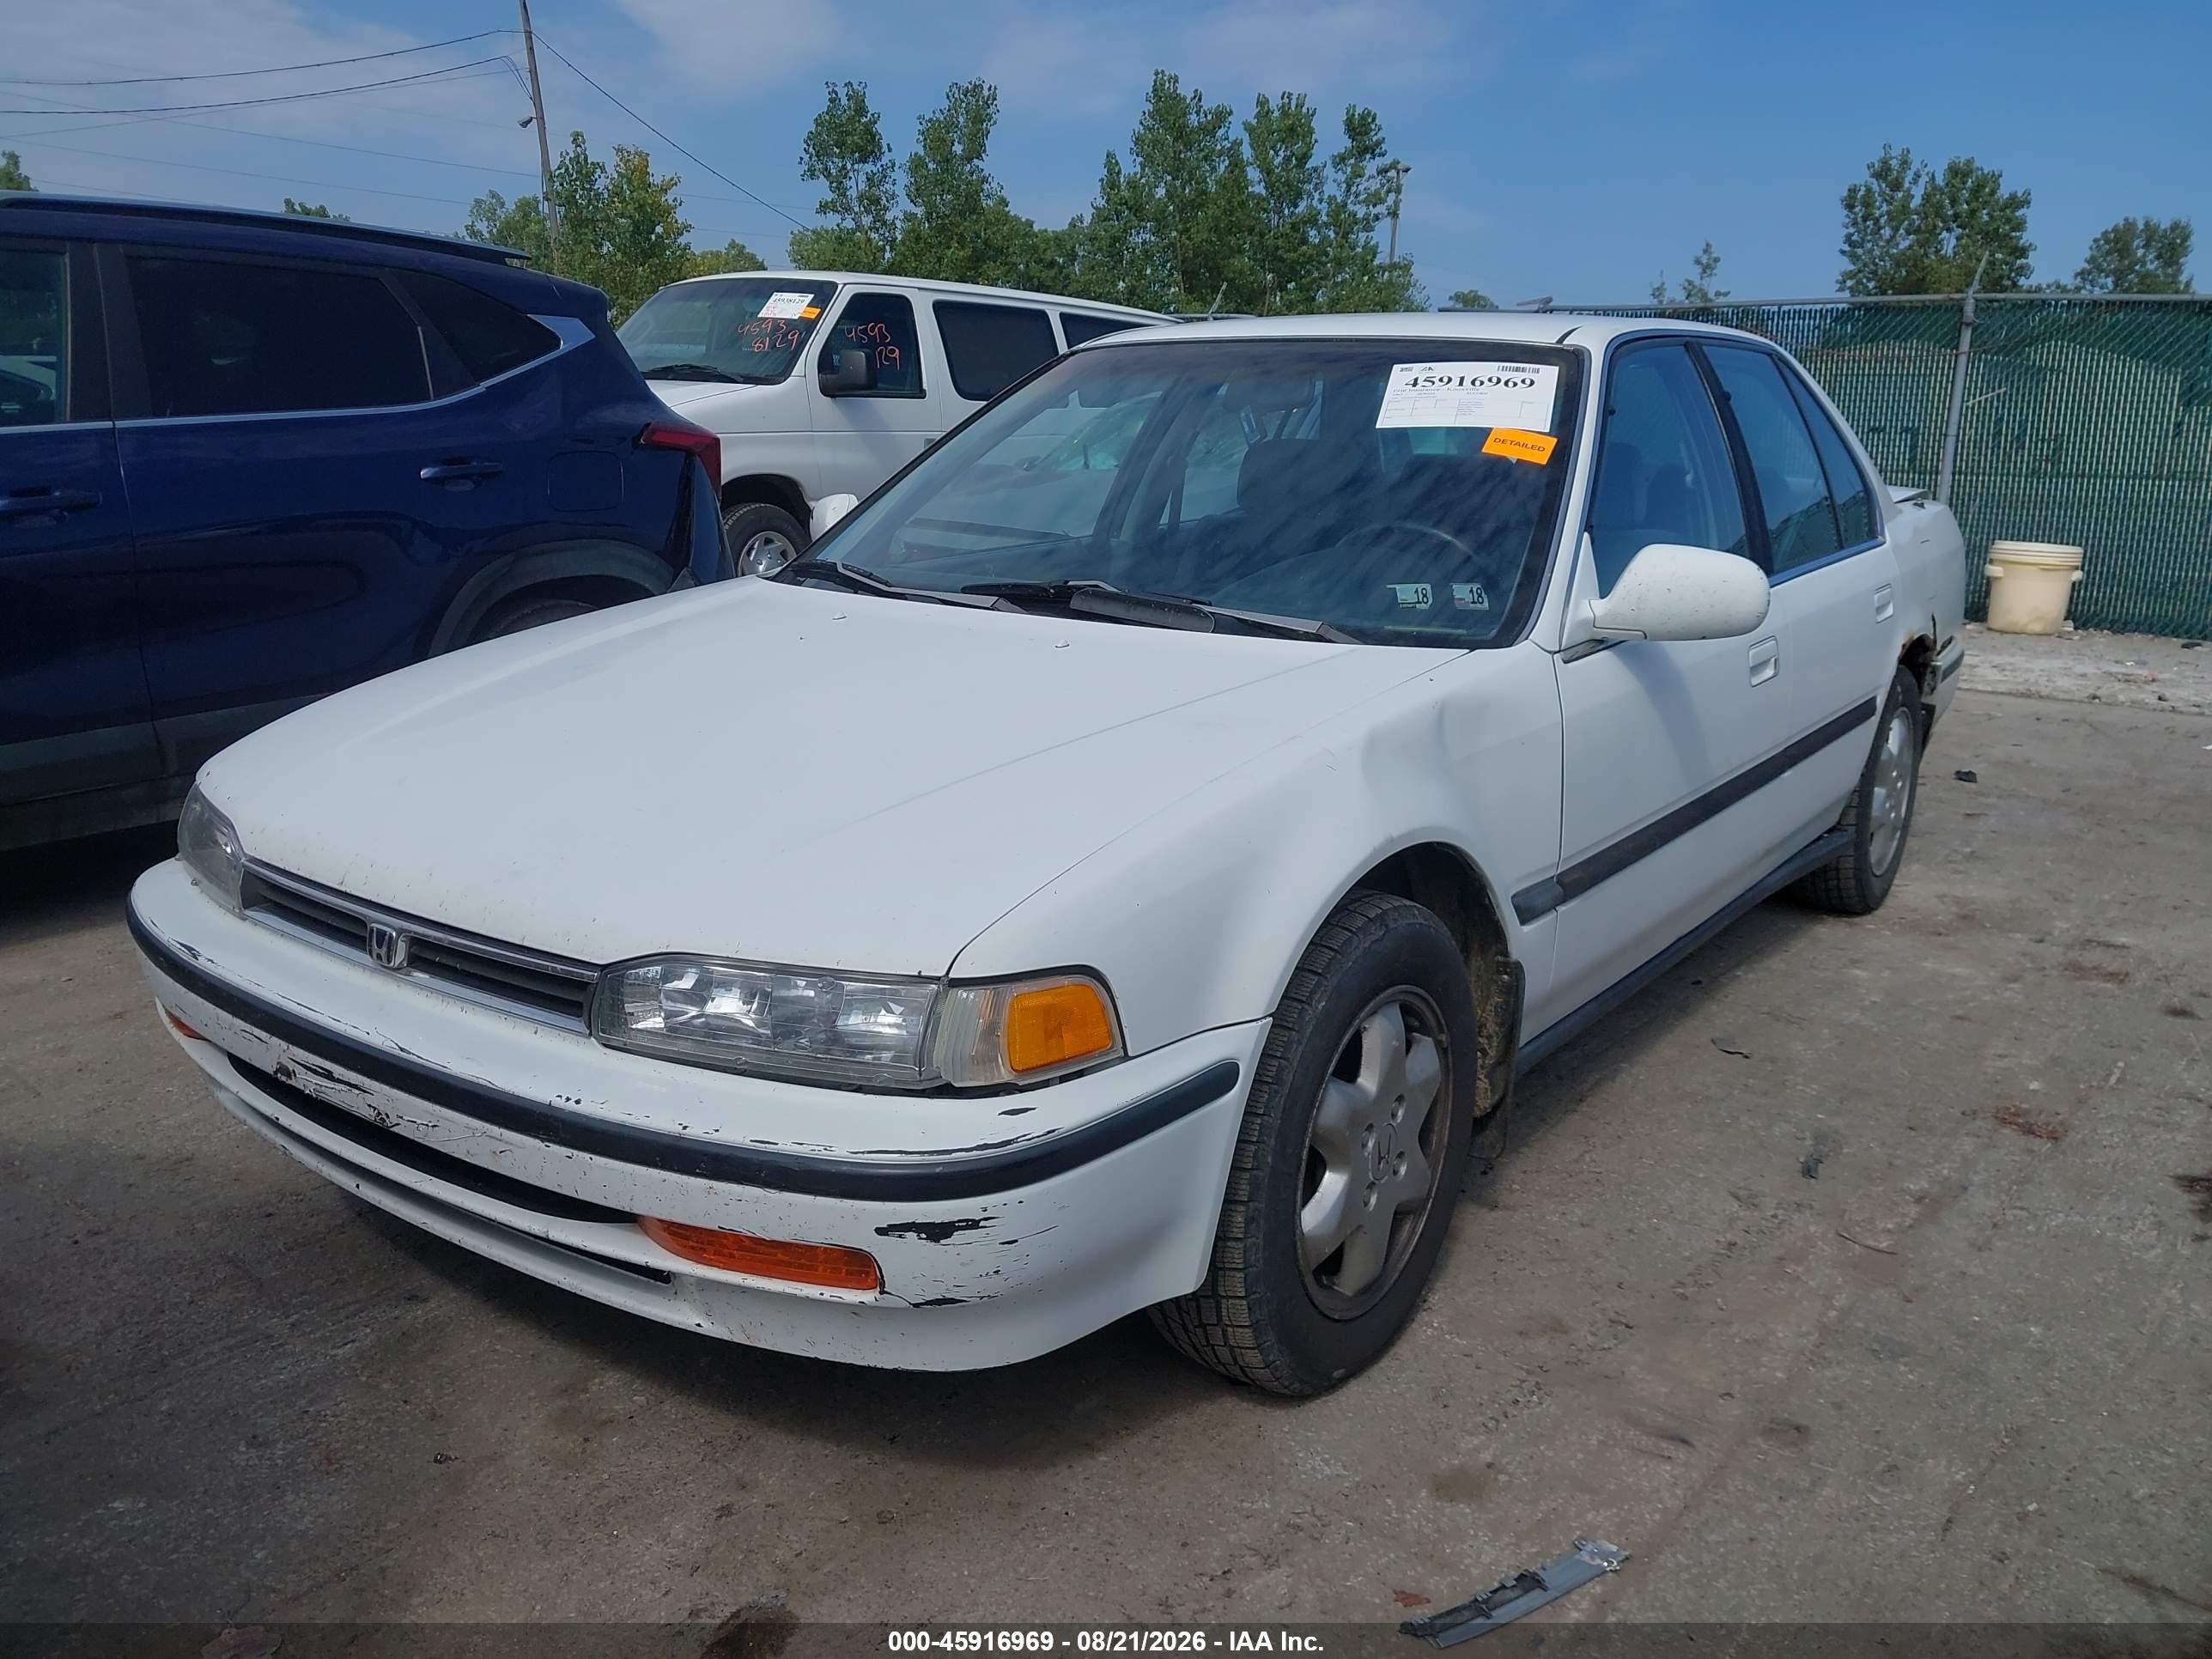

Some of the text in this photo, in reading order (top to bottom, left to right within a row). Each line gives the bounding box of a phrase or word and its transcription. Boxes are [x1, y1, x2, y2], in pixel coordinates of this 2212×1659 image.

[738, 319, 787, 336] 4593
[844, 322, 891, 343] 4593
[751, 329, 799, 352] 8129
[1404, 374, 1536, 389] 45916969
[1492, 437, 1546, 453] DETAILED
[1413, 586, 1430, 605] 18
[1468, 586, 1485, 605] 18
